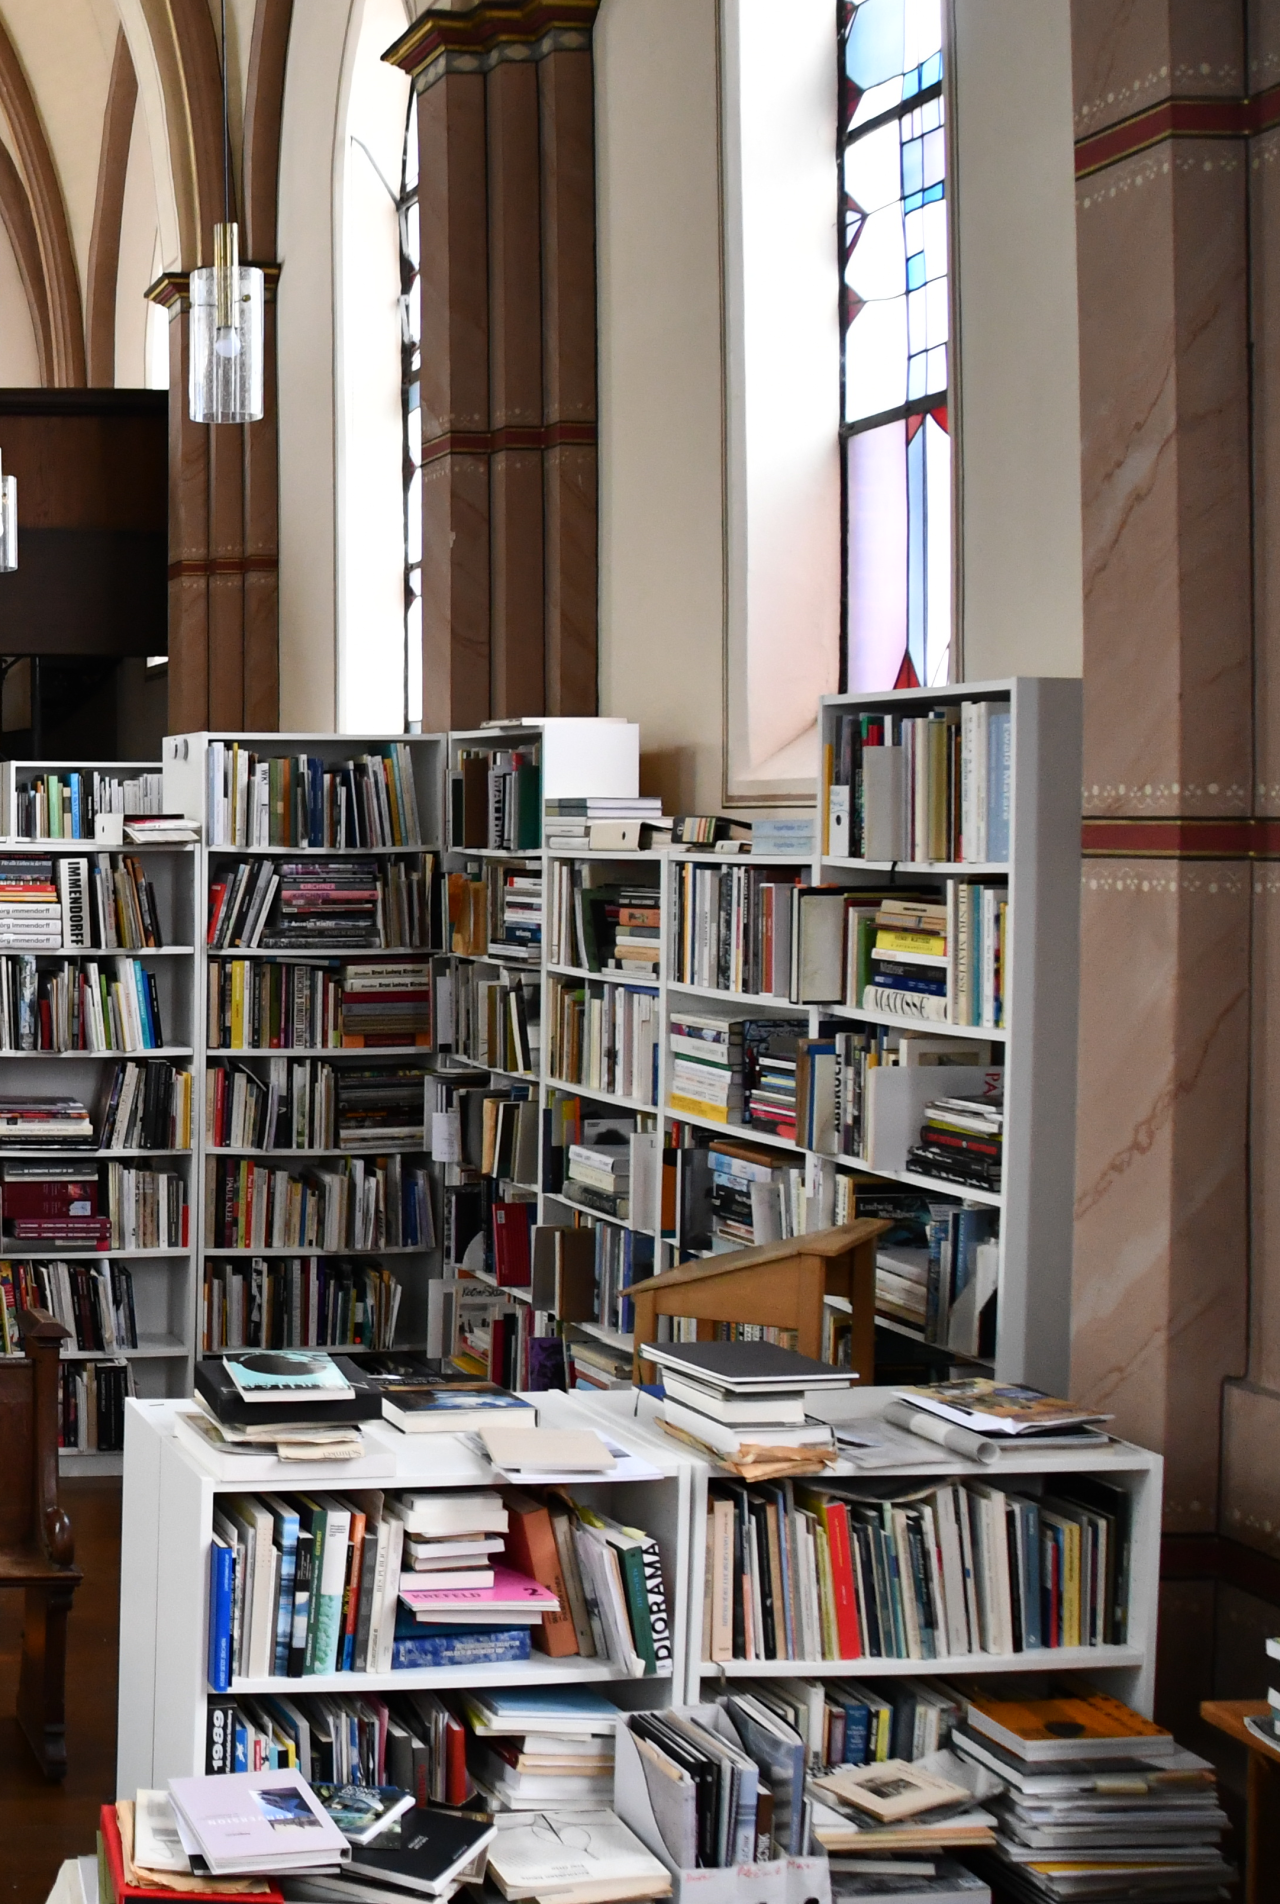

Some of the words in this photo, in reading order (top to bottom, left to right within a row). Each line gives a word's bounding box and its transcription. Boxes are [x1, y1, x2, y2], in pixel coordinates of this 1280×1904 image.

[67, 861, 84, 946] IMMENDORFF
[959, 940, 968, 994] MATISSE
[295, 966, 305, 1000] KIRCHNER
[295, 1001, 305, 1026] LUDWIG
[874, 989, 930, 1019] MATISSE
[295, 1027, 305, 1047] ERNST
[226, 1177, 235, 1200] PAUL
[246, 1174, 254, 1188] Paul
[226, 1201, 234, 1223] KLEE
[322, 1449, 362, 1459] Schinkel
[378, 1546, 387, 1577] PUBLICA
[412, 1592, 481, 1600] KREFELD
[523, 1587, 544, 1596] 2
[642, 1542, 672, 1661] DIORAMA
[212, 1709, 225, 1771] 1989
